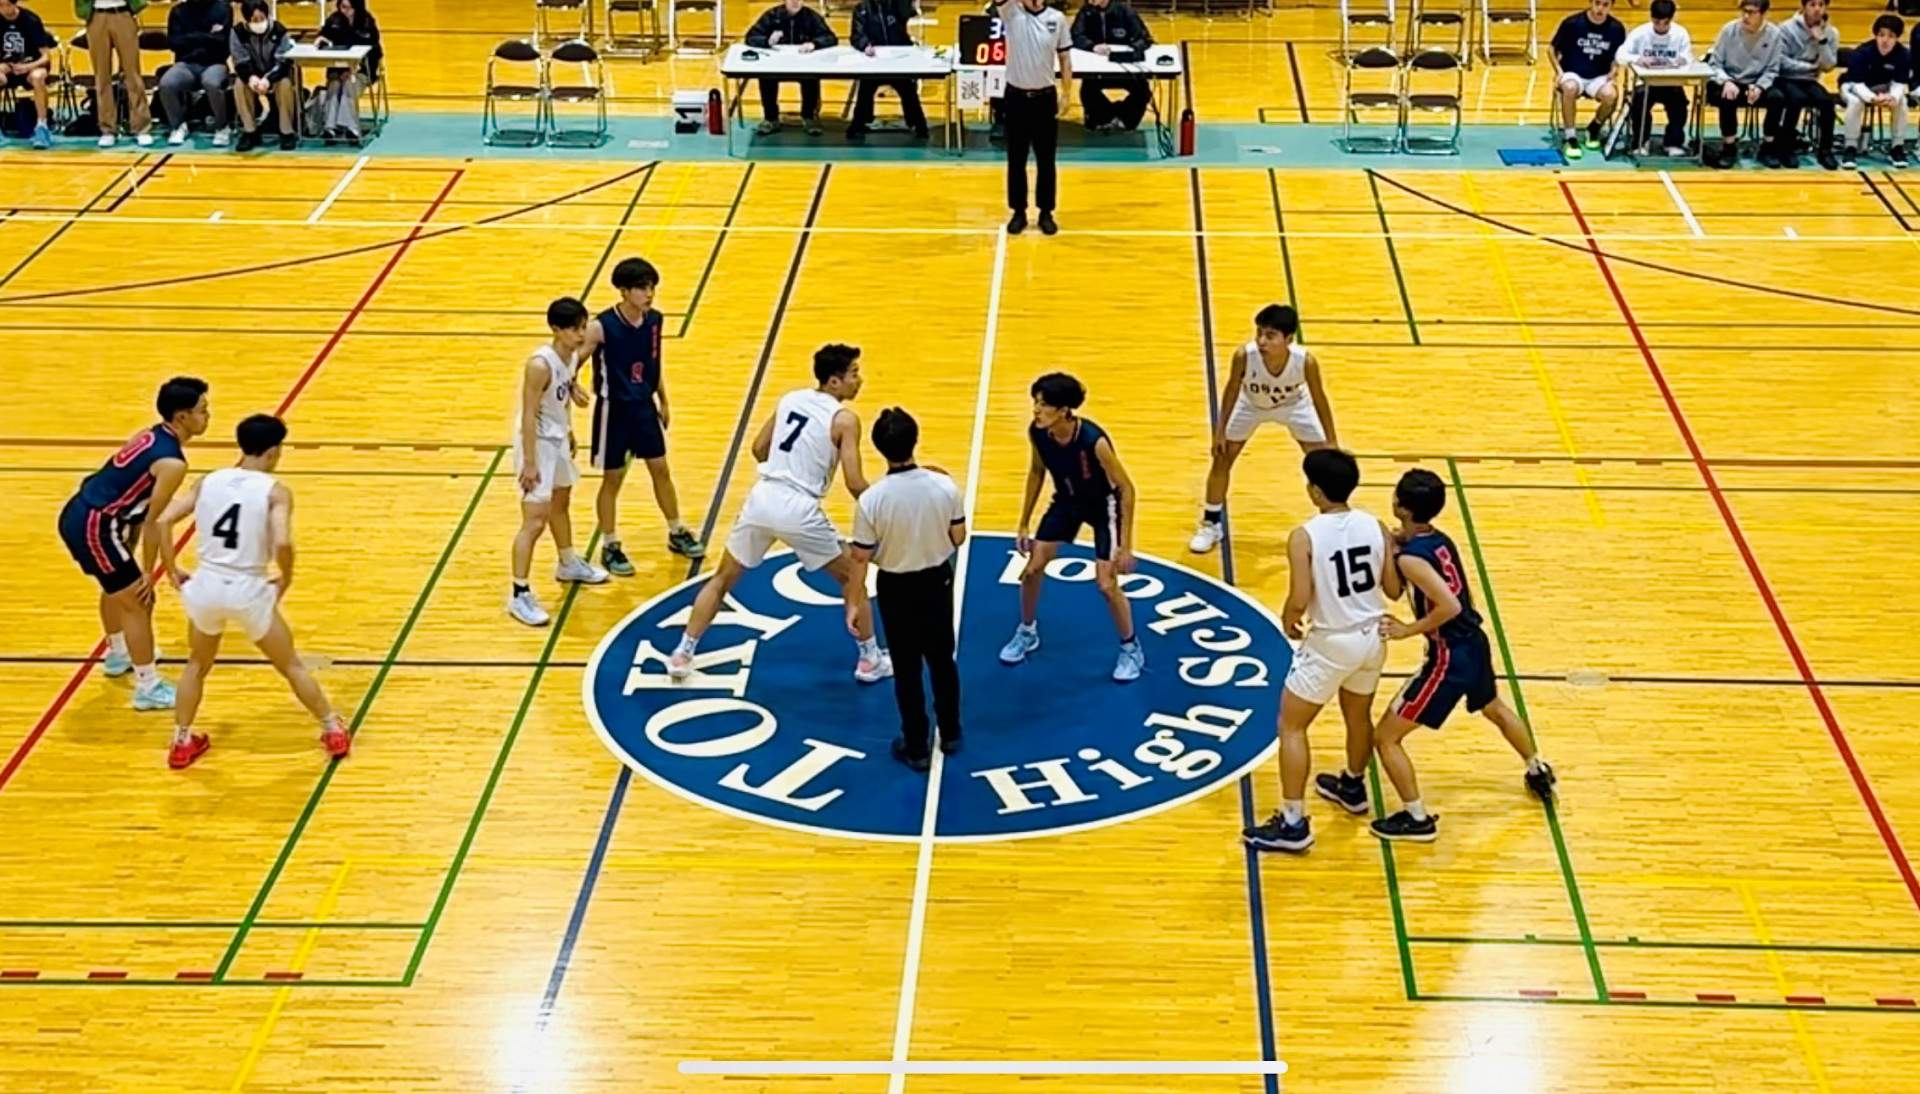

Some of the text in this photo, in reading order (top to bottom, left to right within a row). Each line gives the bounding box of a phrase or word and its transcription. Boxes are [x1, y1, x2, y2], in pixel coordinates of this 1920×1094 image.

[779, 411, 808, 452] 7
[212, 503, 242, 549] 4
[1329, 545, 1376, 598] 15
[998, 549, 1269, 688] School
[973, 703, 1253, 815] High
